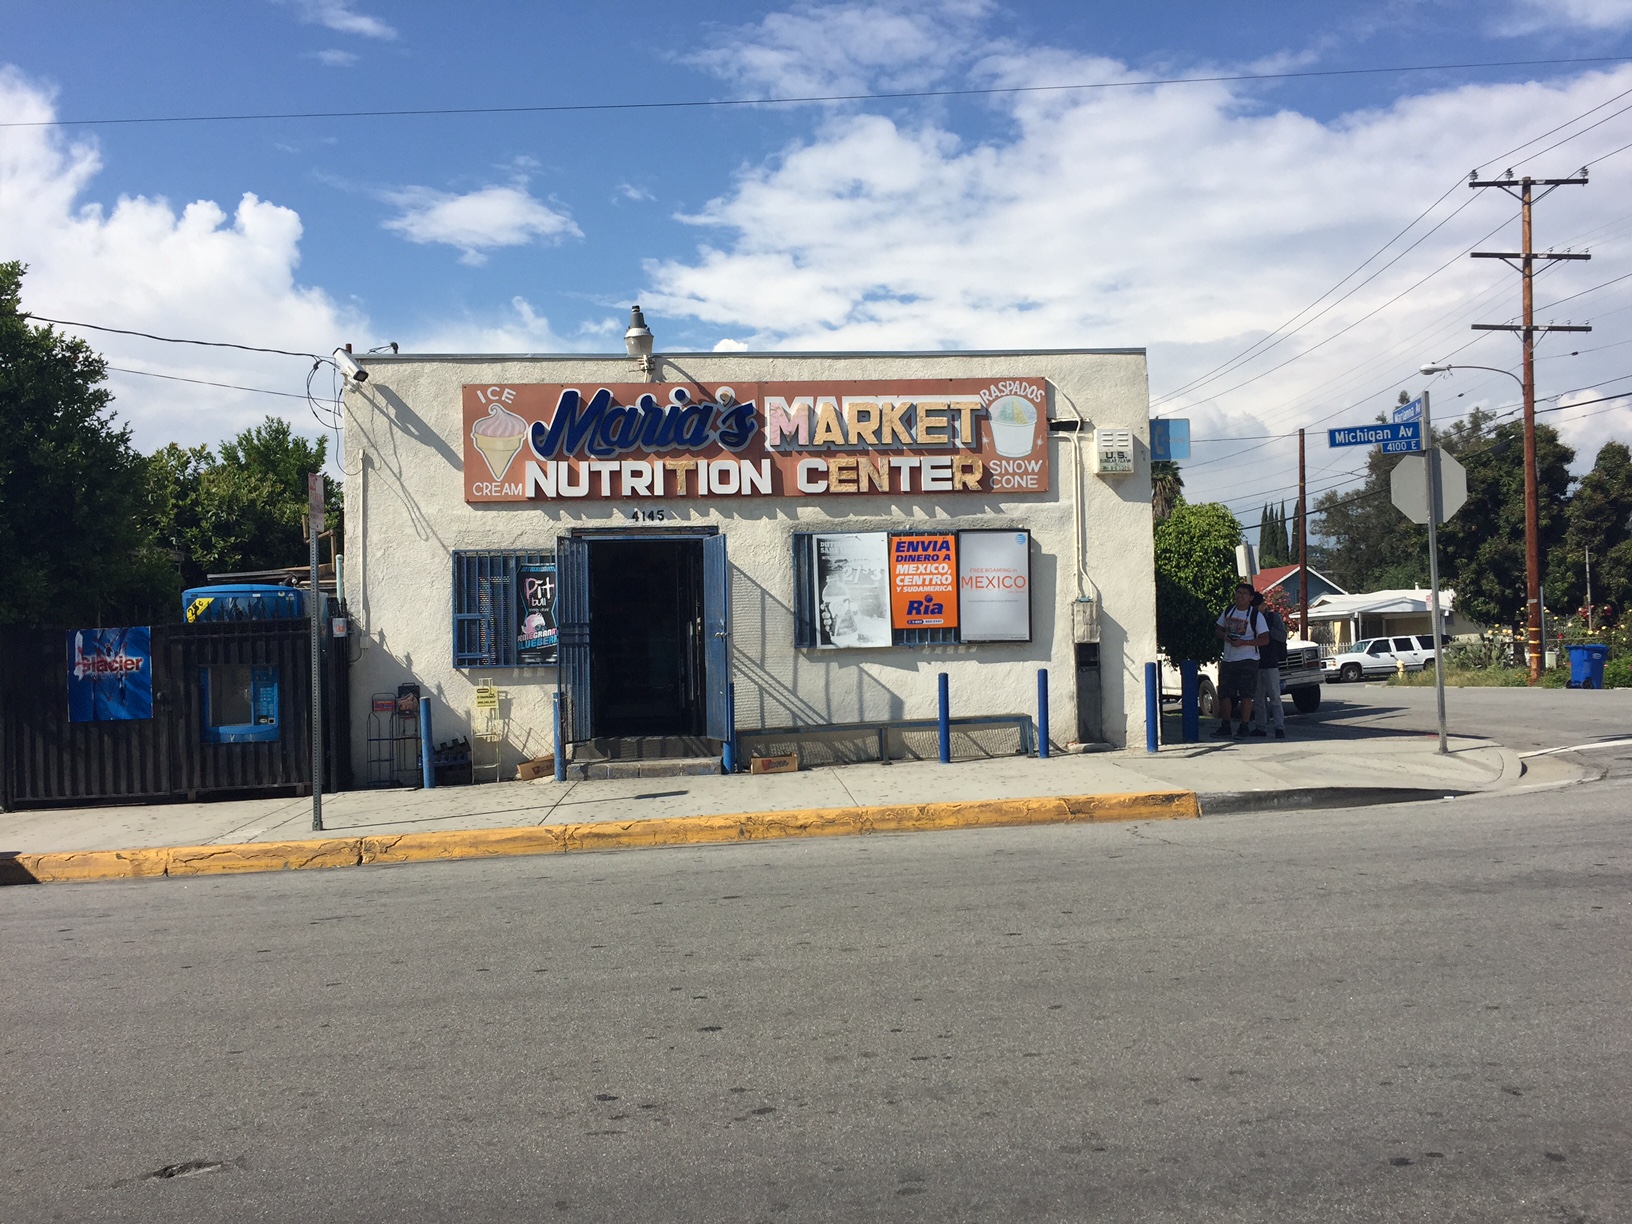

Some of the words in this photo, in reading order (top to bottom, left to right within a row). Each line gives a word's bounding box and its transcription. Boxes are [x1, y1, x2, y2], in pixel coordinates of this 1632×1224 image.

[476, 387, 516, 404] ICE
[979, 380, 1044, 404] RASPADOS
[529, 387, 758, 460] Maria's
[766, 397, 985, 450] MARKET
[1335, 429, 1391, 443] Michigan
[1398, 425, 1413, 438] Av
[1386, 442, 1407, 452] 4100
[1411, 441, 1417, 450] E
[1106, 451, 1127, 459] U.S.
[989, 460, 1043, 475] SNOW
[525, 459, 772, 498] NUTRITION
[797, 456, 983, 493] CENTER
[989, 475, 1038, 488] CONE
[472, 482, 522, 496] CREAM
[632, 510, 665, 521] 4145
[895, 540, 951, 553] ENVIA
[896, 554, 940, 562] DINERO
[943, 553, 952, 562] A
[896, 563, 951, 575] MEXICO,
[896, 574, 953, 586] CENTRO
[961, 575, 1026, 589] MEXICO
[525, 577, 555, 601] Pit
[903, 585, 952, 593] SUDAMERICA
[531, 598, 546, 607] bull
[907, 594, 944, 616] Ria
